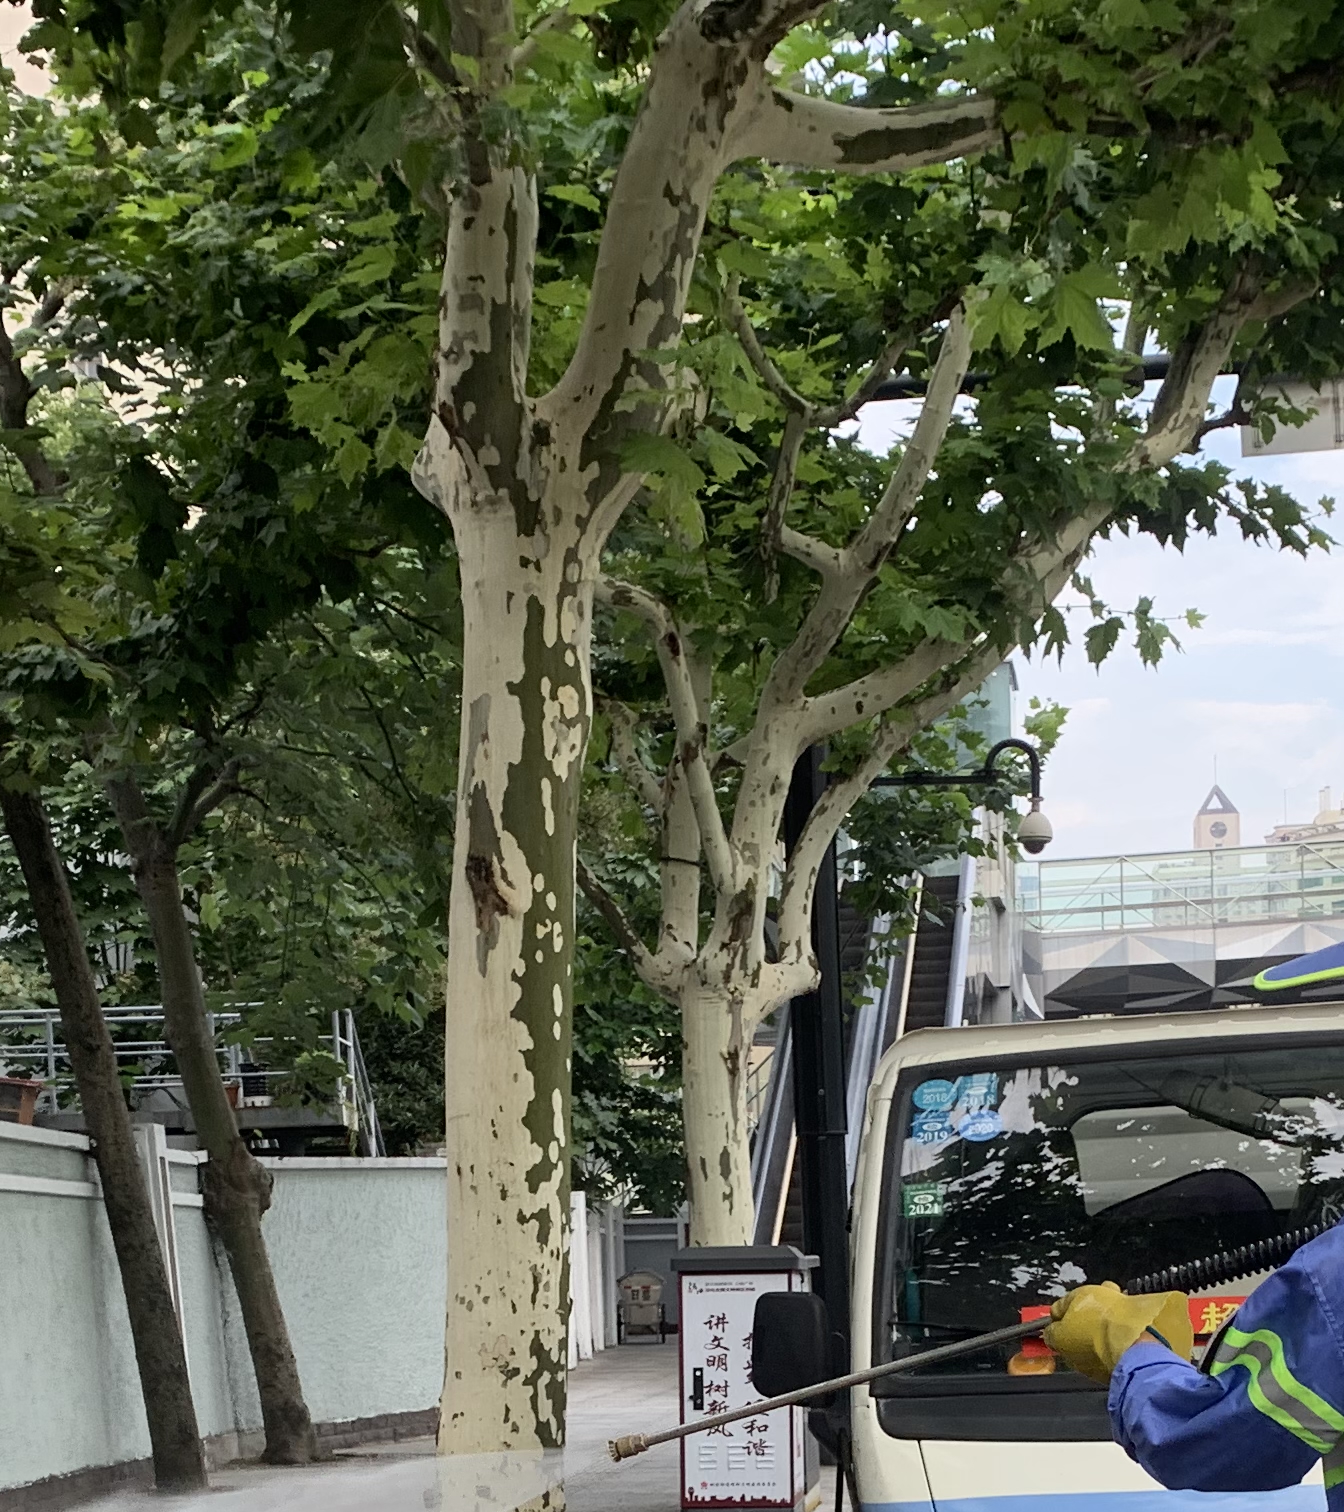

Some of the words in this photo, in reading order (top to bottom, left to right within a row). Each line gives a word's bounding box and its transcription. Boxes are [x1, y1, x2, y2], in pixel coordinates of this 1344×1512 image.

[916, 1131, 948, 1143] 2019
[908, 1202, 939, 1216] 2021
[703, 1312, 730, 1371] 讲文明
